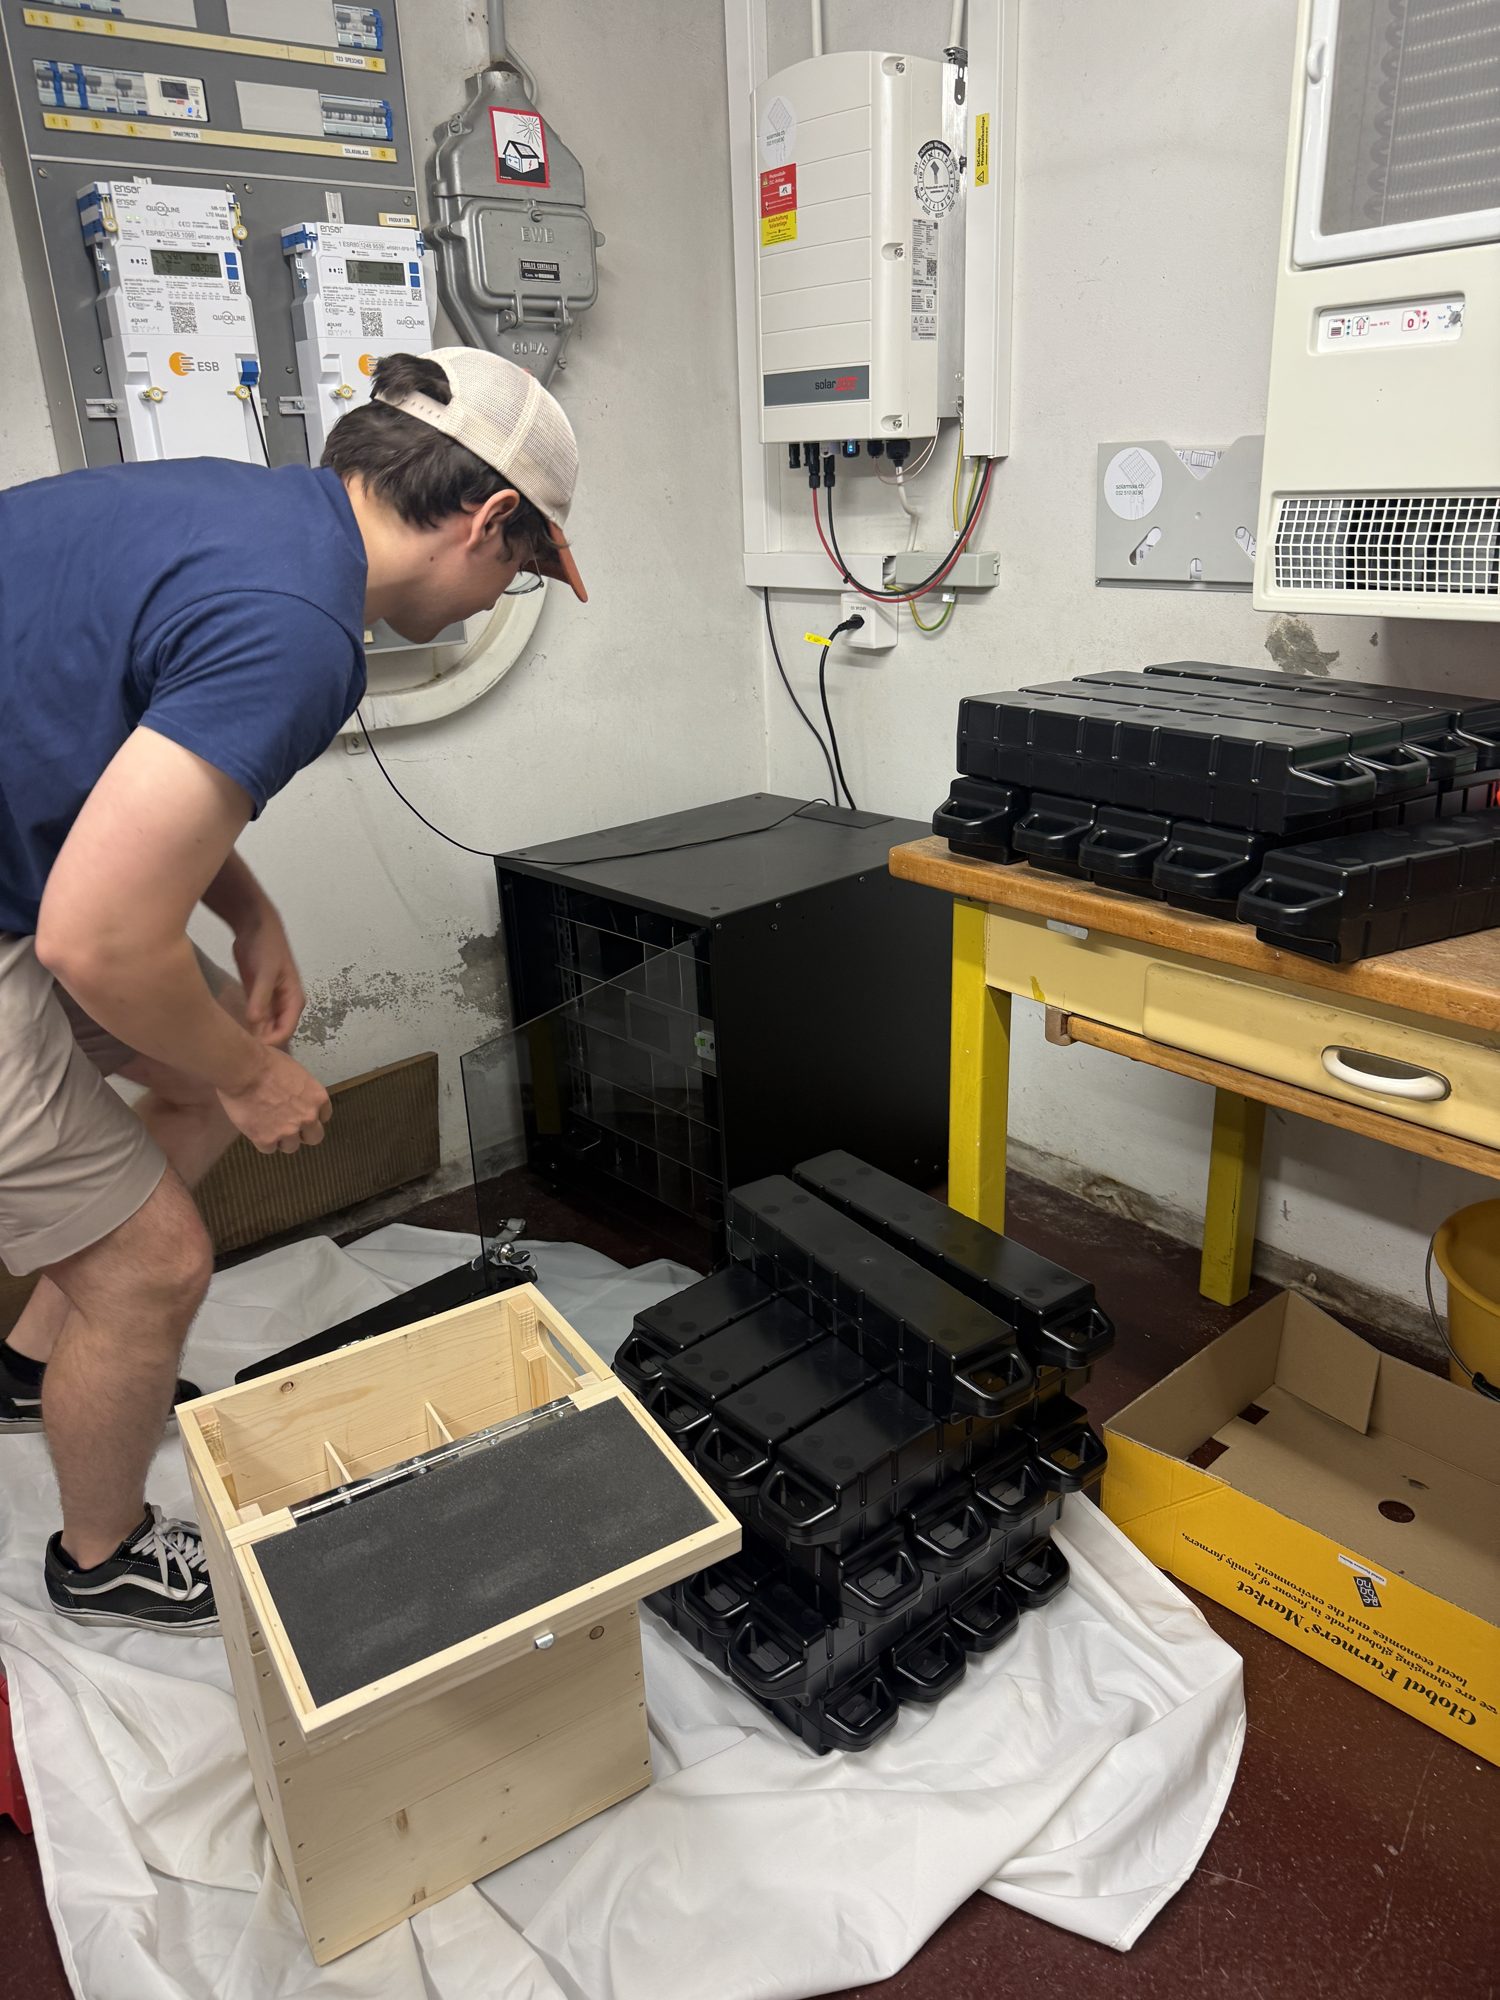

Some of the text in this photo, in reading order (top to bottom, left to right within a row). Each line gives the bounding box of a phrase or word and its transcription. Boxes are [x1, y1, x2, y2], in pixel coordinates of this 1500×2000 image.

[172, 130, 200, 139] SMARTMETER
[197, 361, 220, 372] ESB
[814, 376, 859, 391] solar
[1226, 1557, 1261, 1581] family
[1254, 1562, 1325, 1605] environment.
[1258, 1577, 1270, 1586] of
[1272, 1585, 1311, 1609] favour
[1311, 1605, 1322, 1617] in
[1327, 1603, 1345, 1618] the
[1324, 1614, 1355, 1635] trade
[1347, 1615, 1370, 1631] and
[1236, 1580, 1477, 1726] Global Farmers' Market
[1357, 1632, 1393, 1656] global
[1372, 1629, 1434, 1667] economies
[1395, 1652, 1452, 1689] changing
[1436, 1665, 1468, 1687] local
[1455, 1687, 1477, 1702] are
[1479, 1700, 1499, 1715] we
